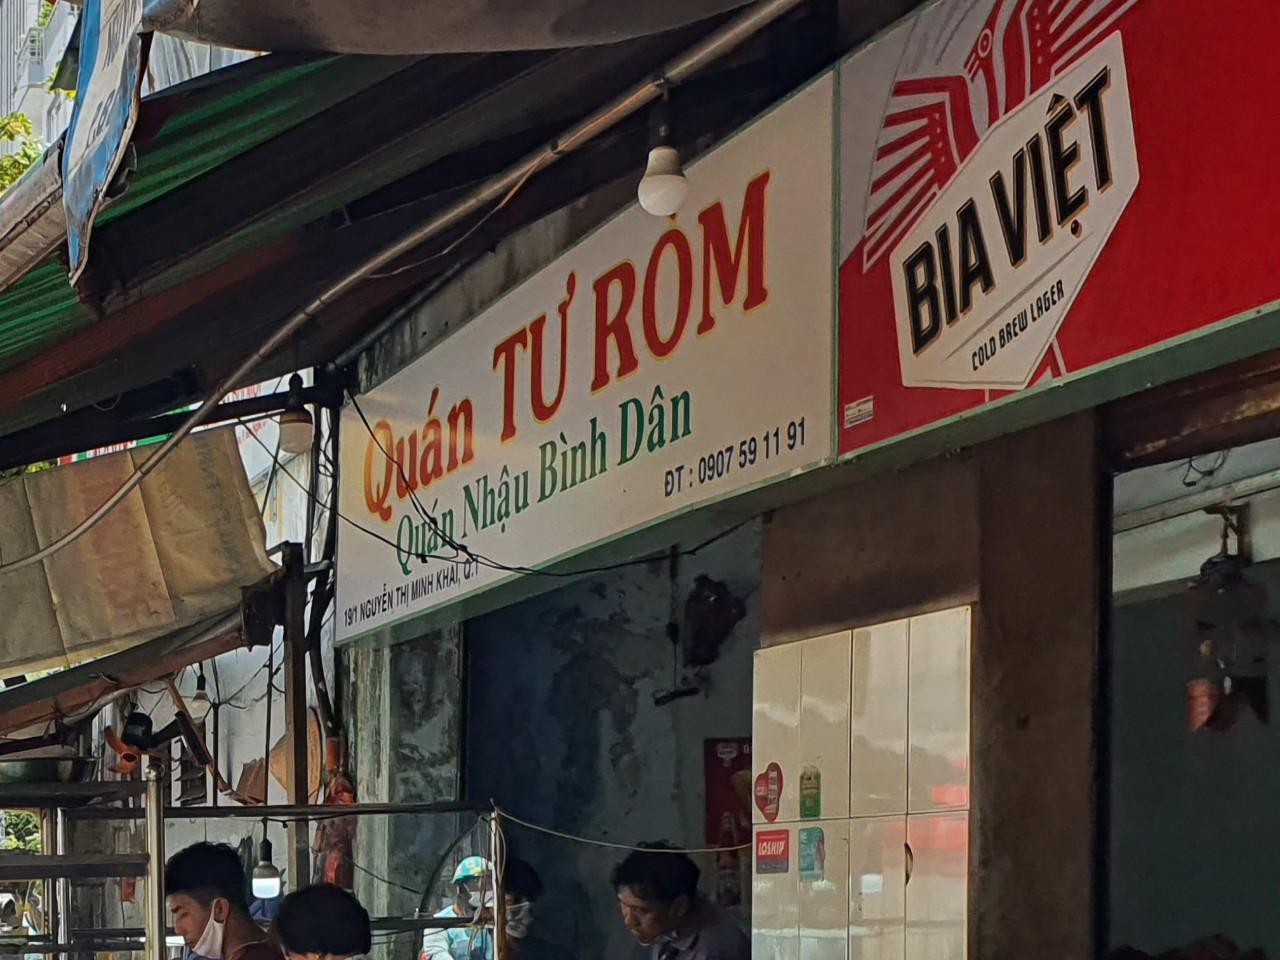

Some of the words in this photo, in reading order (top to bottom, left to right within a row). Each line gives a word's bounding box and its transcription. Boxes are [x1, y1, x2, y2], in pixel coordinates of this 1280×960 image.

[903, 197, 995, 357] BIA
[989, 65, 1113, 269] VIỆT
[971, 341, 997, 371] COLD
[999, 310, 1028, 351] BREW
[1030, 279, 1065, 324] LAGER
[363, 386, 475, 522] Quán
[492, 271, 578, 445] TƯ
[698, 445, 734, 484] 0907
[738, 437, 757, 469] 59
[763, 427, 780, 459] 11
[787, 416, 806, 450] 91
[396, 507, 456, 576] Quán
[461, 464, 530, 541] Nhậu
[538, 415, 608, 503] Bình
[616, 384, 693, 467] Dân
[360, 583, 393, 622] NGUYỄN
[395, 583, 409, 608] THỊ
[411, 575, 433, 601] MINH
